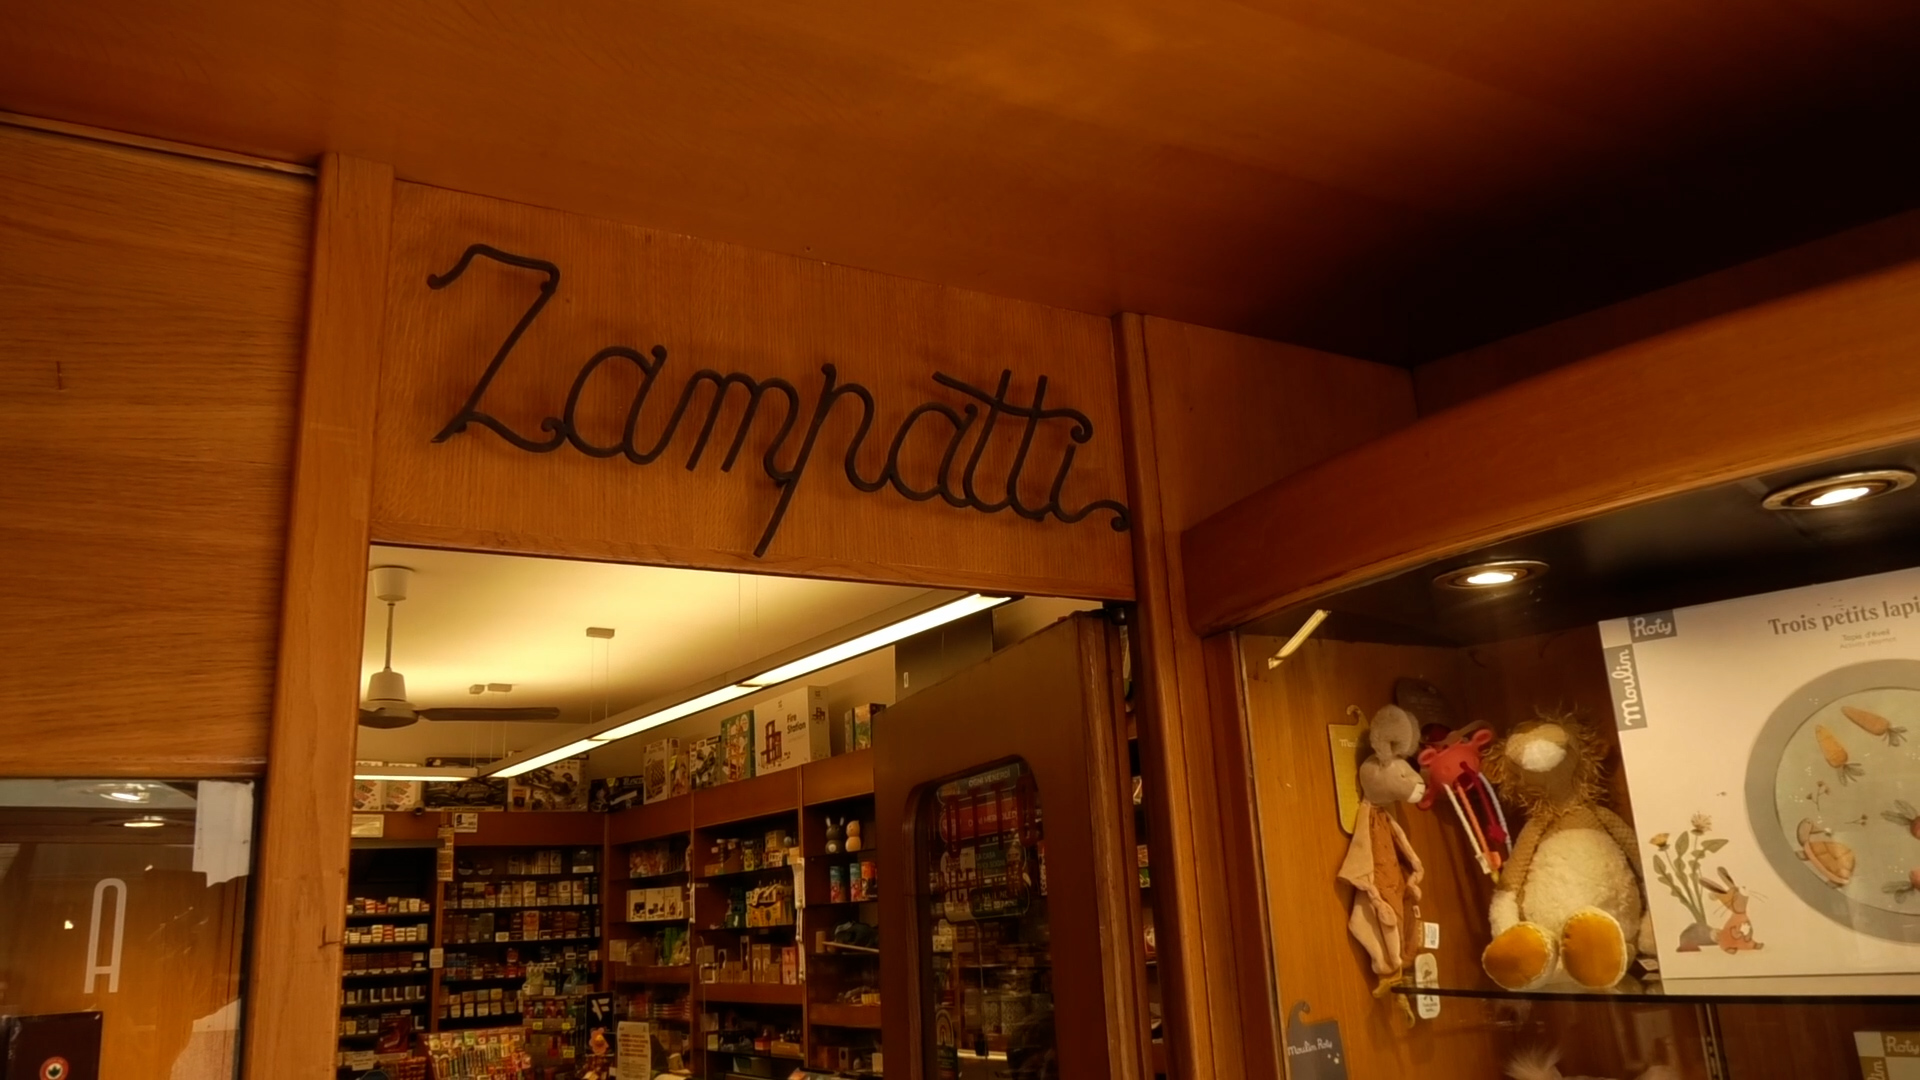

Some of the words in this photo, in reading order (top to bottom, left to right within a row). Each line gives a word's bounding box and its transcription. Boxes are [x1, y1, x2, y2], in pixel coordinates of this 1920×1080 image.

[427, 243, 1130, 558] Zampatti
[1633, 617, 1673, 638] Roty
[1768, 614, 1817, 636] Trois
[1823, 604, 1880, 631] petits
[1611, 649, 1642, 726] Moulin
[786, 713, 797, 723] Fire
[787, 721, 806, 734] Station
[1885, 1035, 1920, 1055] Roty
